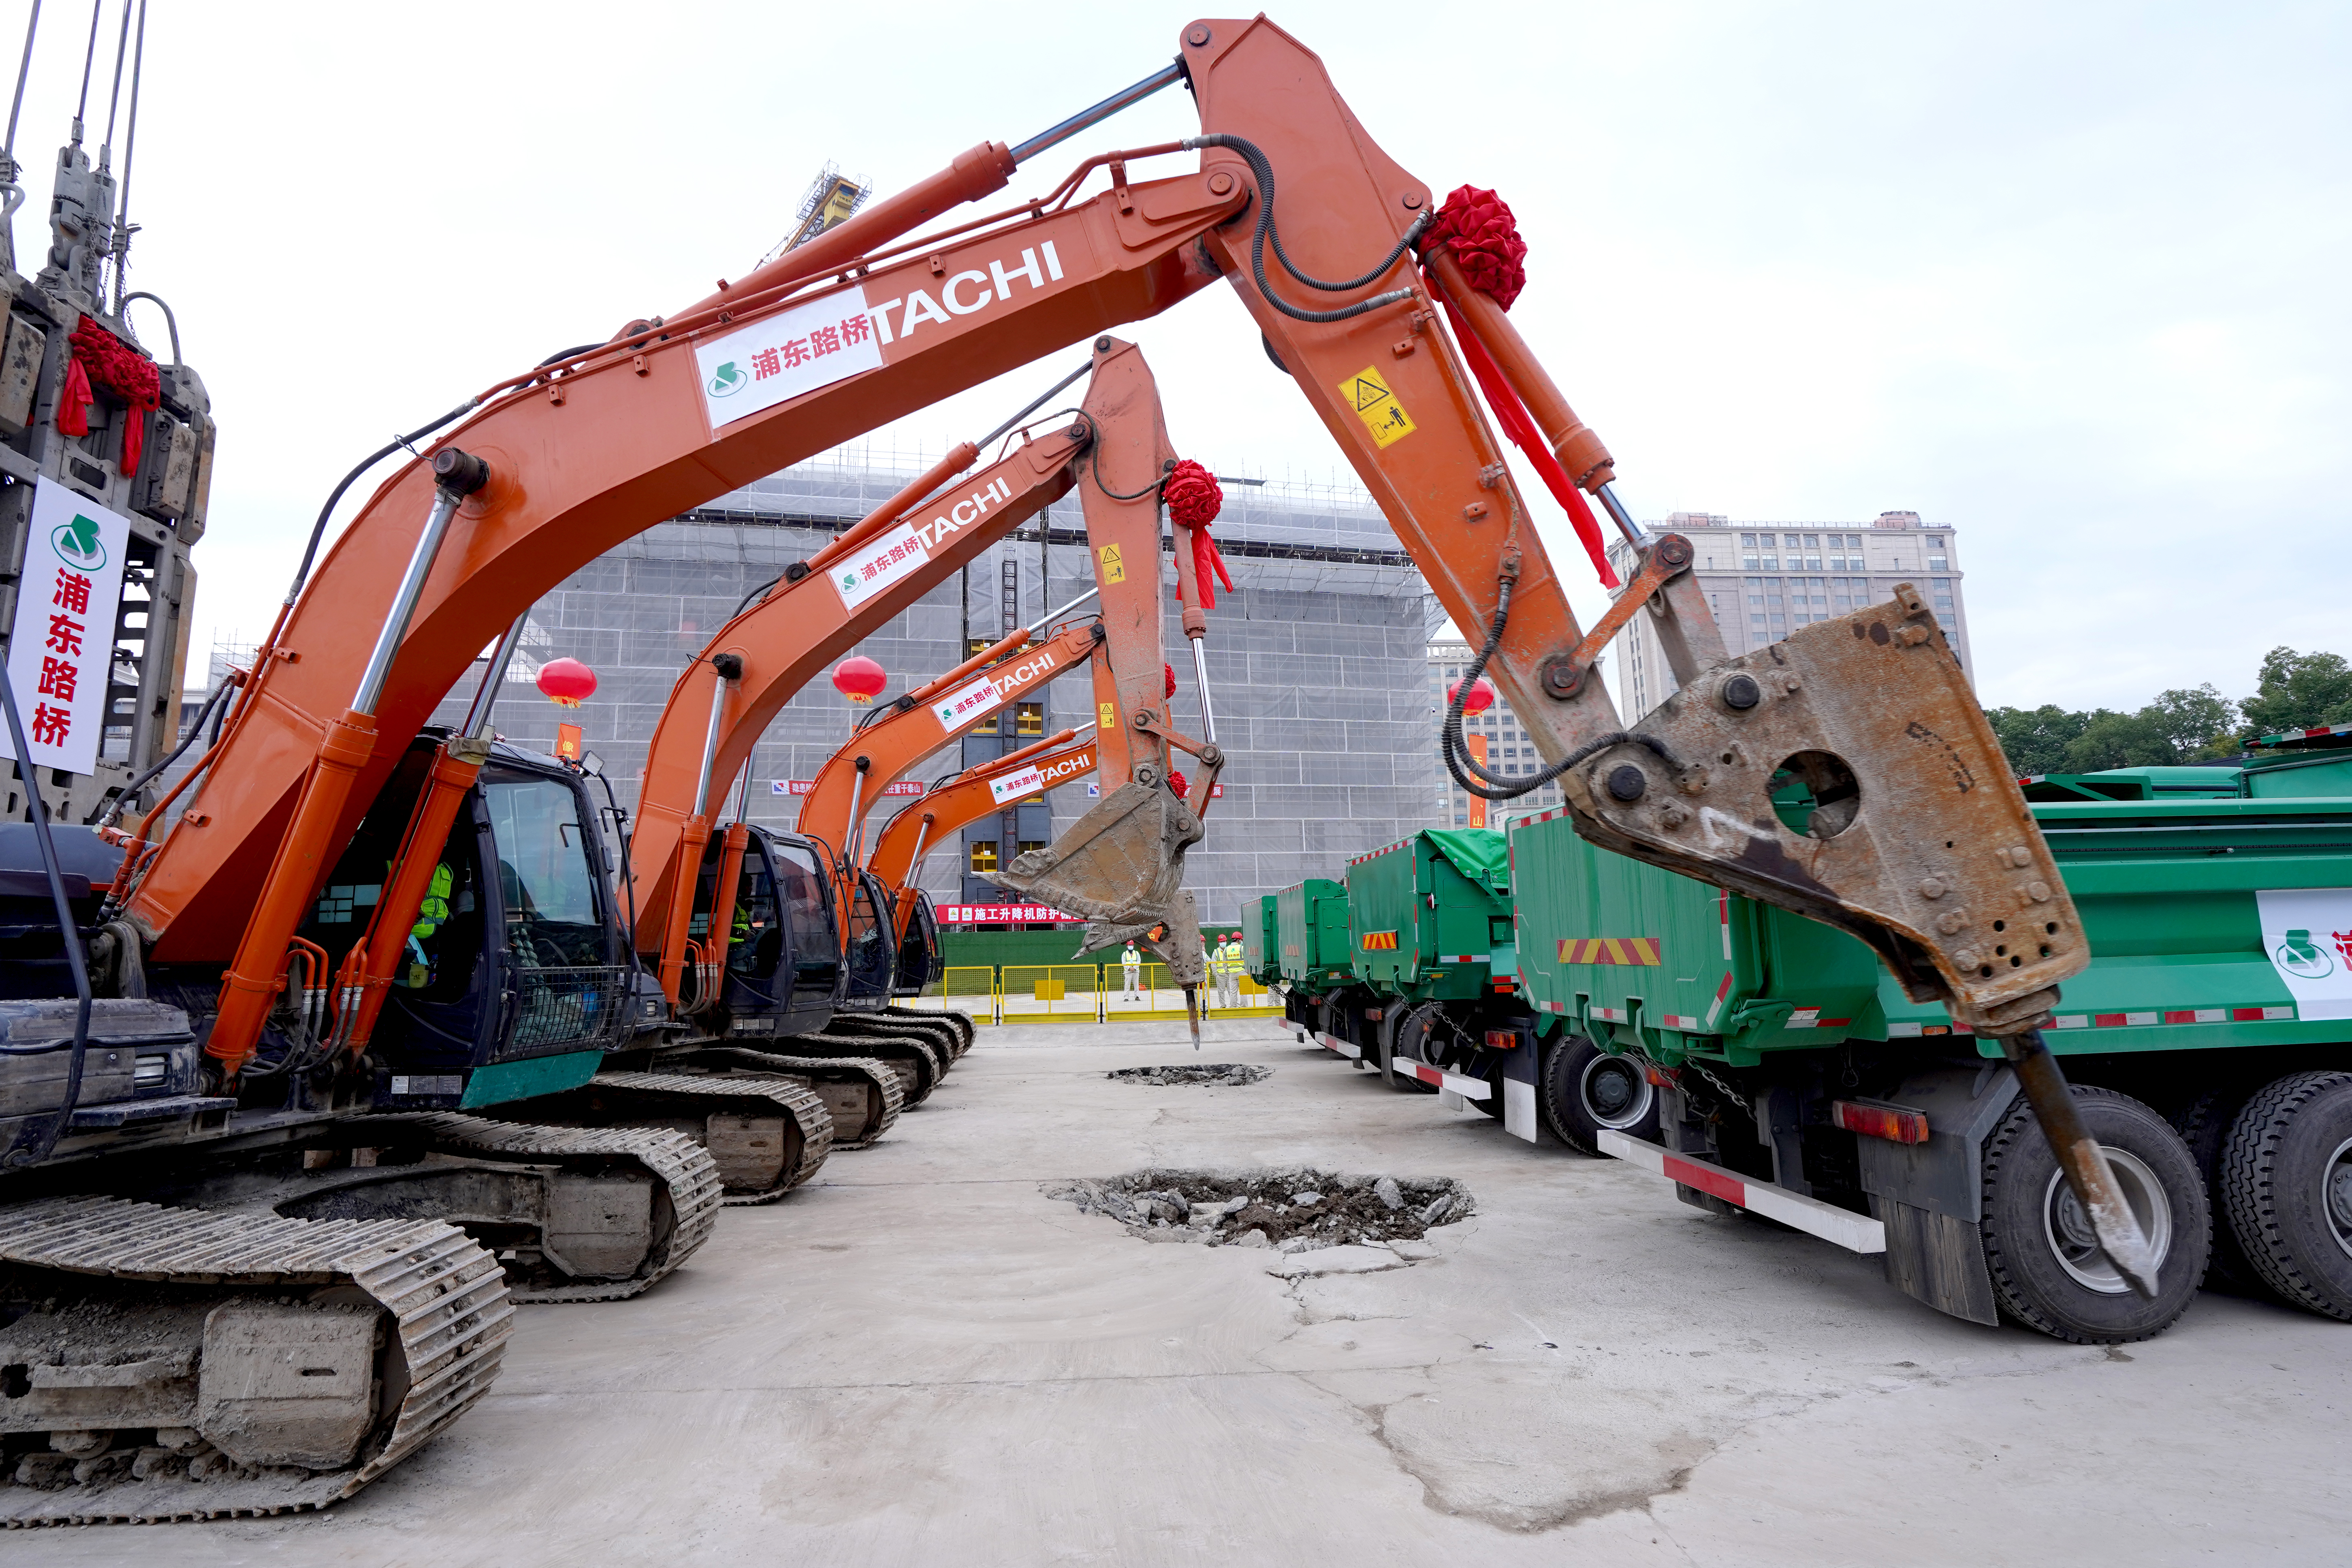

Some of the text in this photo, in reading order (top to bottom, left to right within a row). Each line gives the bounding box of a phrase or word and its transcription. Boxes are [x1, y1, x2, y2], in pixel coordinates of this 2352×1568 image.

[751, 314, 869, 380] 浦东路桥
[860, 536, 919, 581] 浦东路桥
[33, 567, 92, 747] 浦东路桥
[954, 685, 995, 714] 浦东路桥
[885, 783, 920, 794] 任重于泰山
[1005, 773, 1039, 791] 浦东路桥
[1213, 787, 1221, 796] 展
[974, 907, 1080, 920] 施工升降机防护
